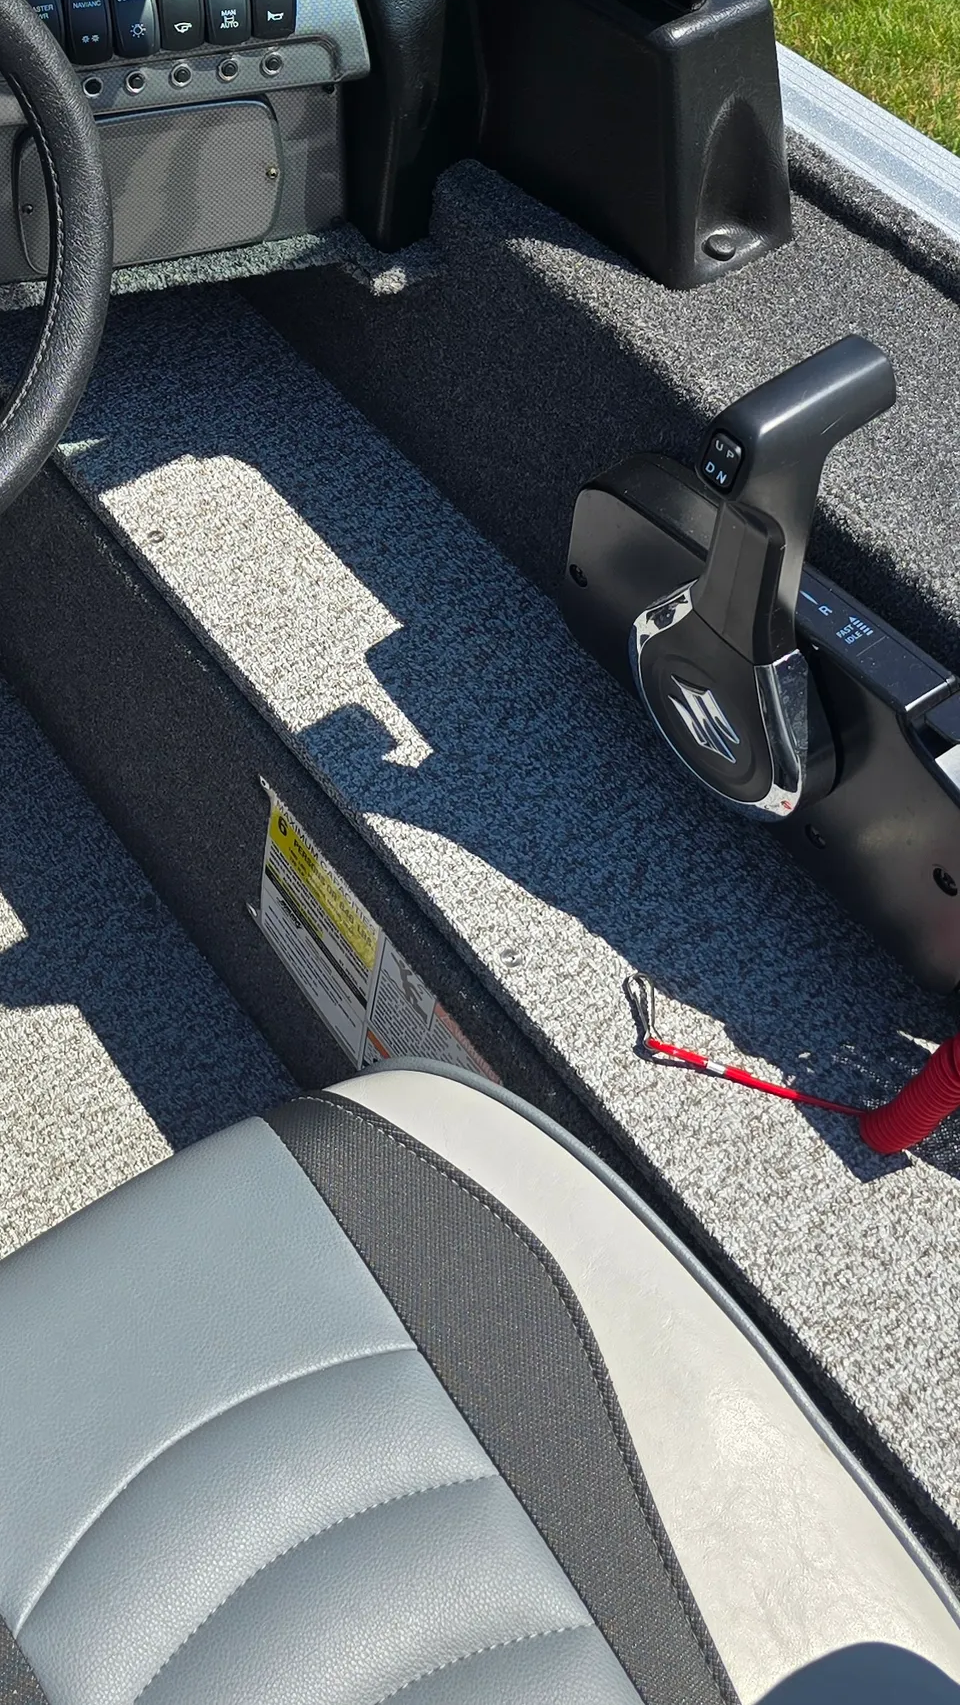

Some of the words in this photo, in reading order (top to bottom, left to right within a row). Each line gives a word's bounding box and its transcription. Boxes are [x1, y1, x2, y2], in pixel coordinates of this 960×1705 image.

[221, 9, 237, 17] MAN
[220, 21, 239, 30] AUTO
[715, 439, 735, 459] UP
[705, 461, 728, 485] DN
[818, 605, 833, 616] R
[835, 623, 855, 639] FAST
[844, 630, 864, 645] IDLE
[275, 797, 319, 861] MAXIMUM
[277, 812, 288, 839] 6
